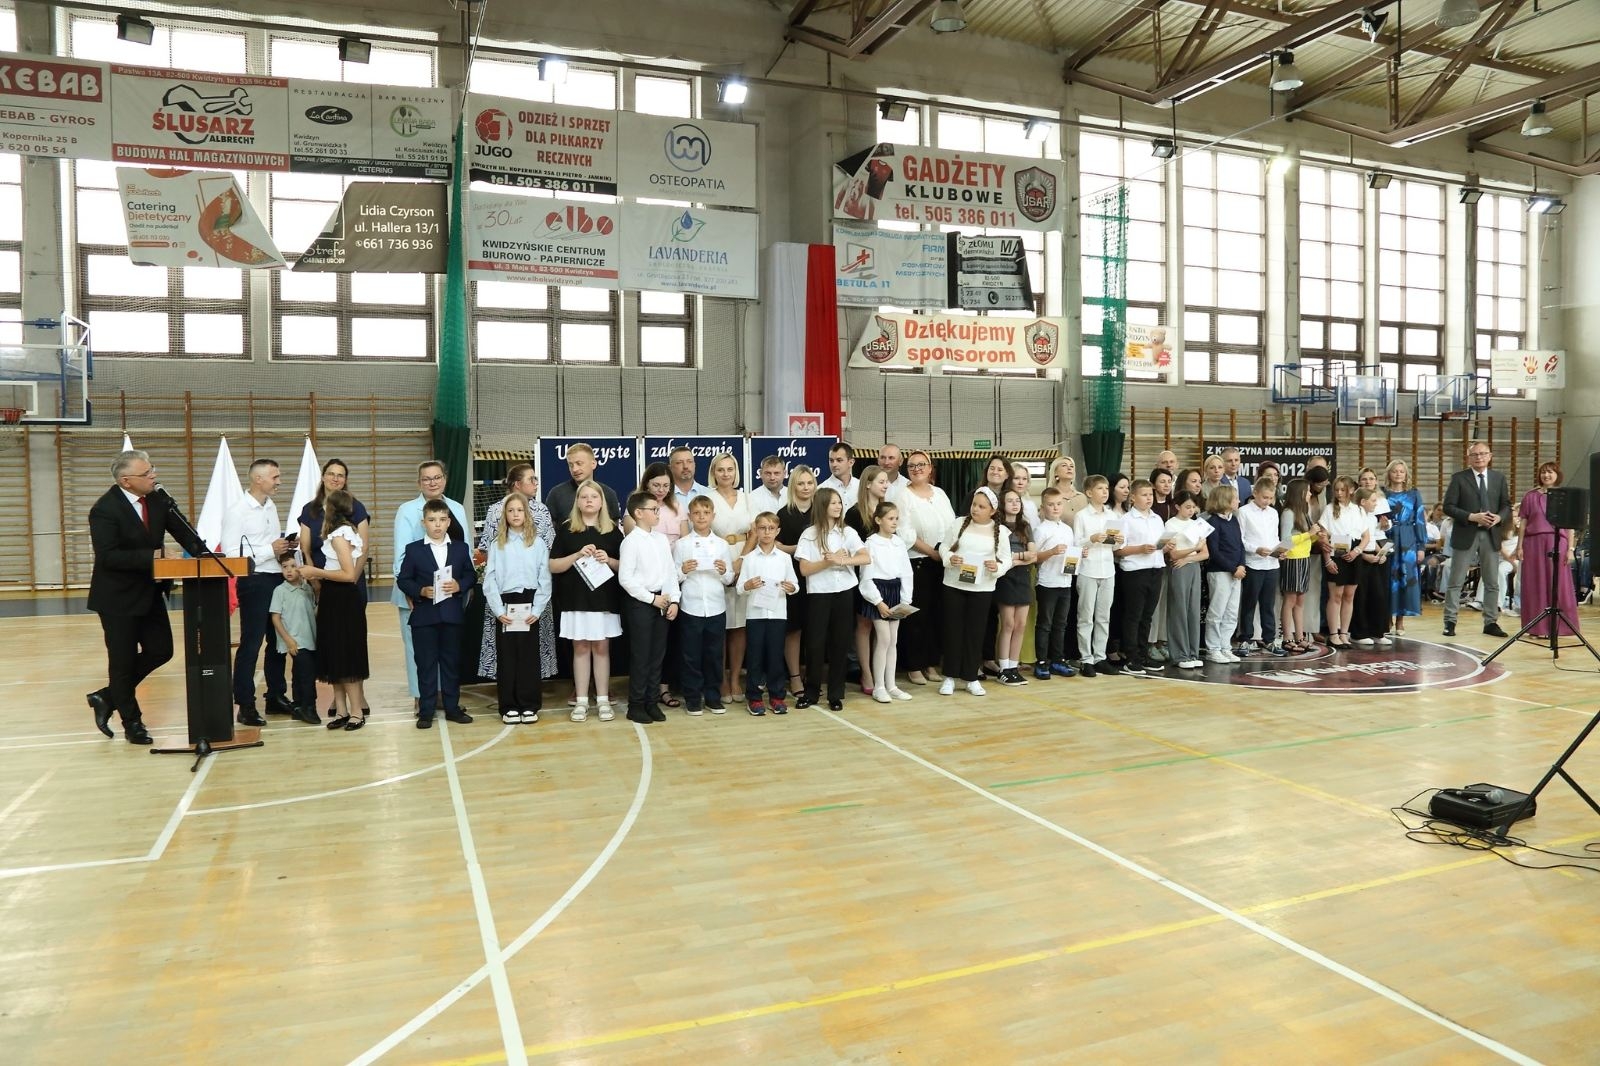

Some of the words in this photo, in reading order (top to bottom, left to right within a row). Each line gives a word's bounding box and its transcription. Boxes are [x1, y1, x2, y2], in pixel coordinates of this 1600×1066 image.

[50, 115, 95, 126] GYROS
[152, 108, 254, 135] ŚLUSARZ
[518, 111, 558, 127] ODZIEŻ
[562, 116, 565, 127] I
[569, 117, 610, 133] SPRZĘT
[2, 132, 53, 142] Kopernika
[209, 134, 254, 144] ALBRECHT
[526, 130, 546, 144] DLA
[550, 133, 604, 150] PIŁKARZY
[8, 144, 30, 152] 620
[117, 146, 165, 159] BUDOWA
[169, 150, 190, 162] HAL
[194, 152, 284, 166] MAGAZYNOWYCH
[474, 144, 512, 158] JUGO
[537, 150, 592, 167] RĘCZNYCH
[358, 166, 393, 174] CETERING
[903, 154, 1006, 188] GADŻETY
[491, 175, 513, 185] tel.
[516, 177, 541, 188] 505
[544, 179, 569, 190] 386
[572, 182, 595, 192] 011
[650, 174, 725, 190] OSTEOPATIA
[905, 184, 1003, 205] KLUBOWE
[127, 202, 176, 213] Catering
[360, 205, 386, 216] Lidia
[390, 206, 434, 219] Czyrson
[895, 204, 919, 220] tel.
[925, 206, 952, 223] 505
[958, 207, 985, 224] 386
[990, 210, 1015, 227] 011
[128, 212, 192, 223] Dietetyczny
[484, 210, 510, 228] 30
[546, 206, 613, 235] elbo
[354, 222, 368, 232] ul.
[372, 222, 411, 233] Hallera
[415, 223, 439, 234] 13/1
[363, 239, 383, 249] 661
[388, 239, 409, 249] 736
[412, 240, 433, 250] 936
[482, 240, 553, 252] KWIDZYŃSKIE
[557, 245, 606, 256] CENTRUM
[968, 240, 994, 249] ZŁOMU
[482, 250, 531, 261] BIUROWO
[540, 255, 605, 267] PAPIERNICZE
[648, 246, 728, 264] LAVANDERIA
[904, 319, 1015, 345] Dziękujemy
[907, 346, 1016, 364] sponsorom
[555, 443, 630, 466] Uzyste
[651, 439, 732, 458] zakczenie
[777, 439, 807, 457] roku
[1207, 446, 1213, 454] Z
[1265, 447, 1283, 456] MOC
[1285, 448, 1332, 456] NADCHODZI
